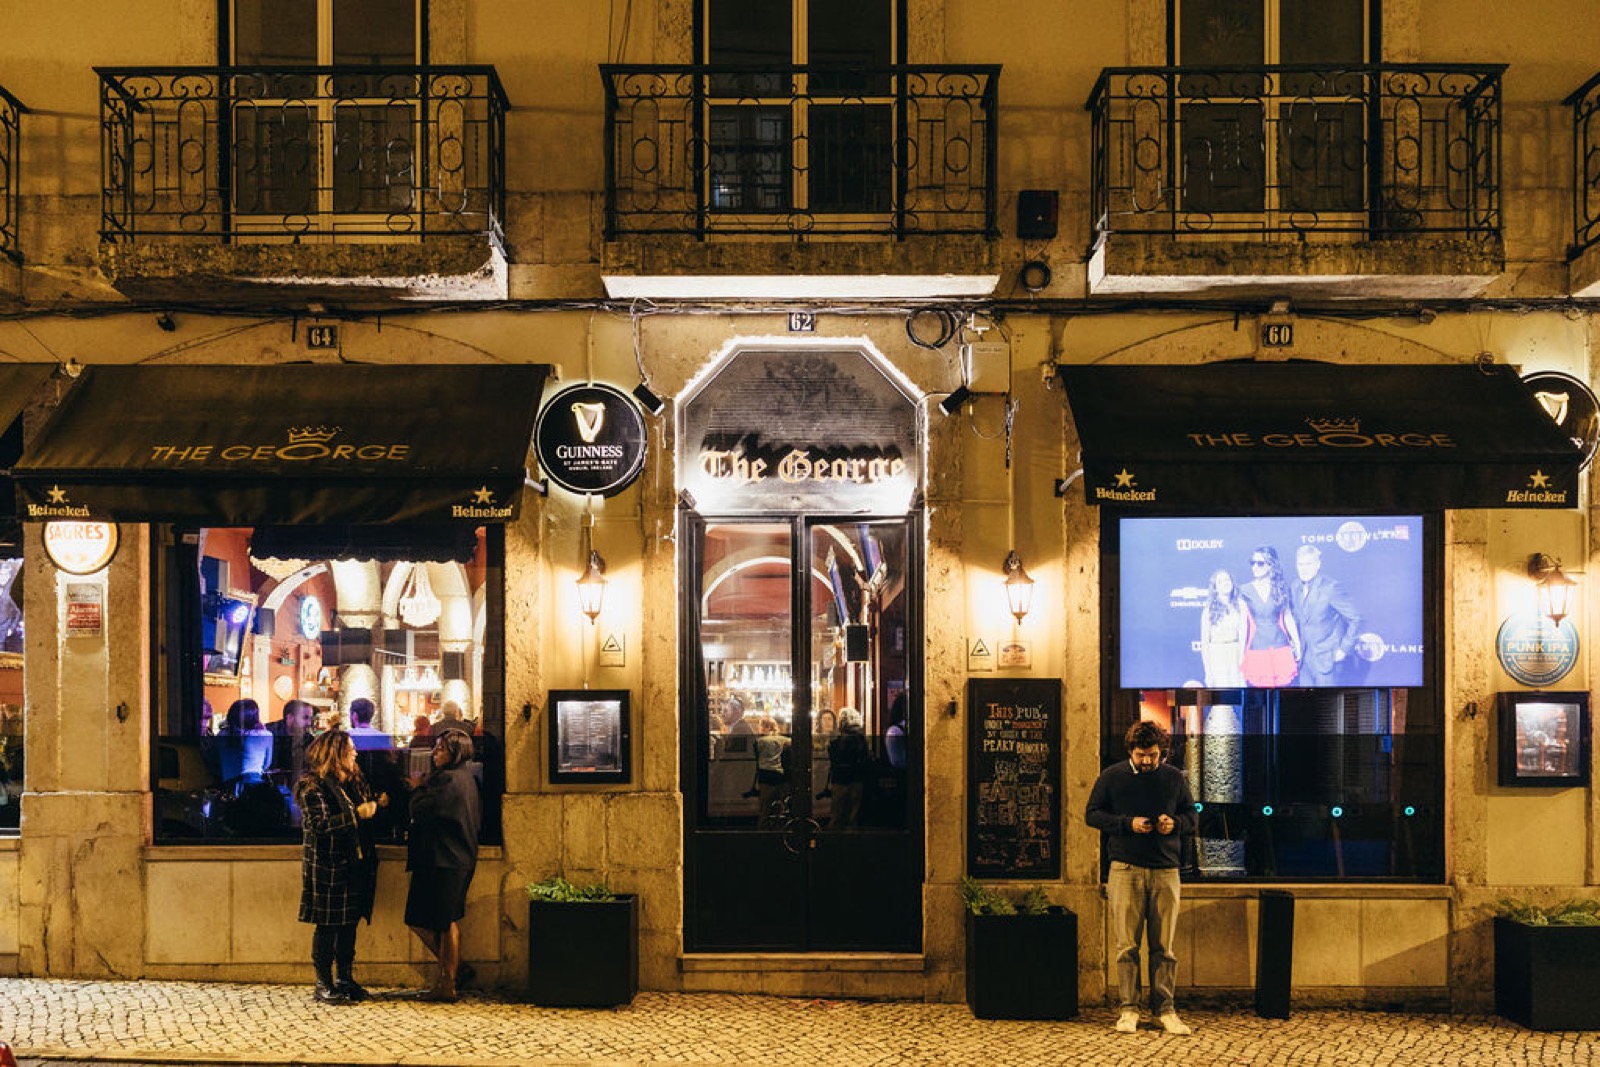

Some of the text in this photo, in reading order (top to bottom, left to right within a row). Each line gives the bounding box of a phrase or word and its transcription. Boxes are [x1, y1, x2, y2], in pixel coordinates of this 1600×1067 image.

[791, 312, 812, 330] 62
[311, 327, 331, 346] 64
[1269, 326, 1290, 344] 60
[1187, 433, 1456, 448] THE GEORGE
[150, 443, 410, 461] THE GEORGE
[699, 447, 906, 485] The George
[1095, 487, 1156, 502] Heineken
[1505, 490, 1566, 503] Heineken
[27, 503, 91, 517] Heineken
[452, 505, 513, 518] Heineken
[48, 523, 104, 540] SAGRES
[1191, 539, 1224, 549] DOLBY
[1506, 641, 1571, 653] PUNK IPA
[983, 739, 1015, 752] PEAKY
